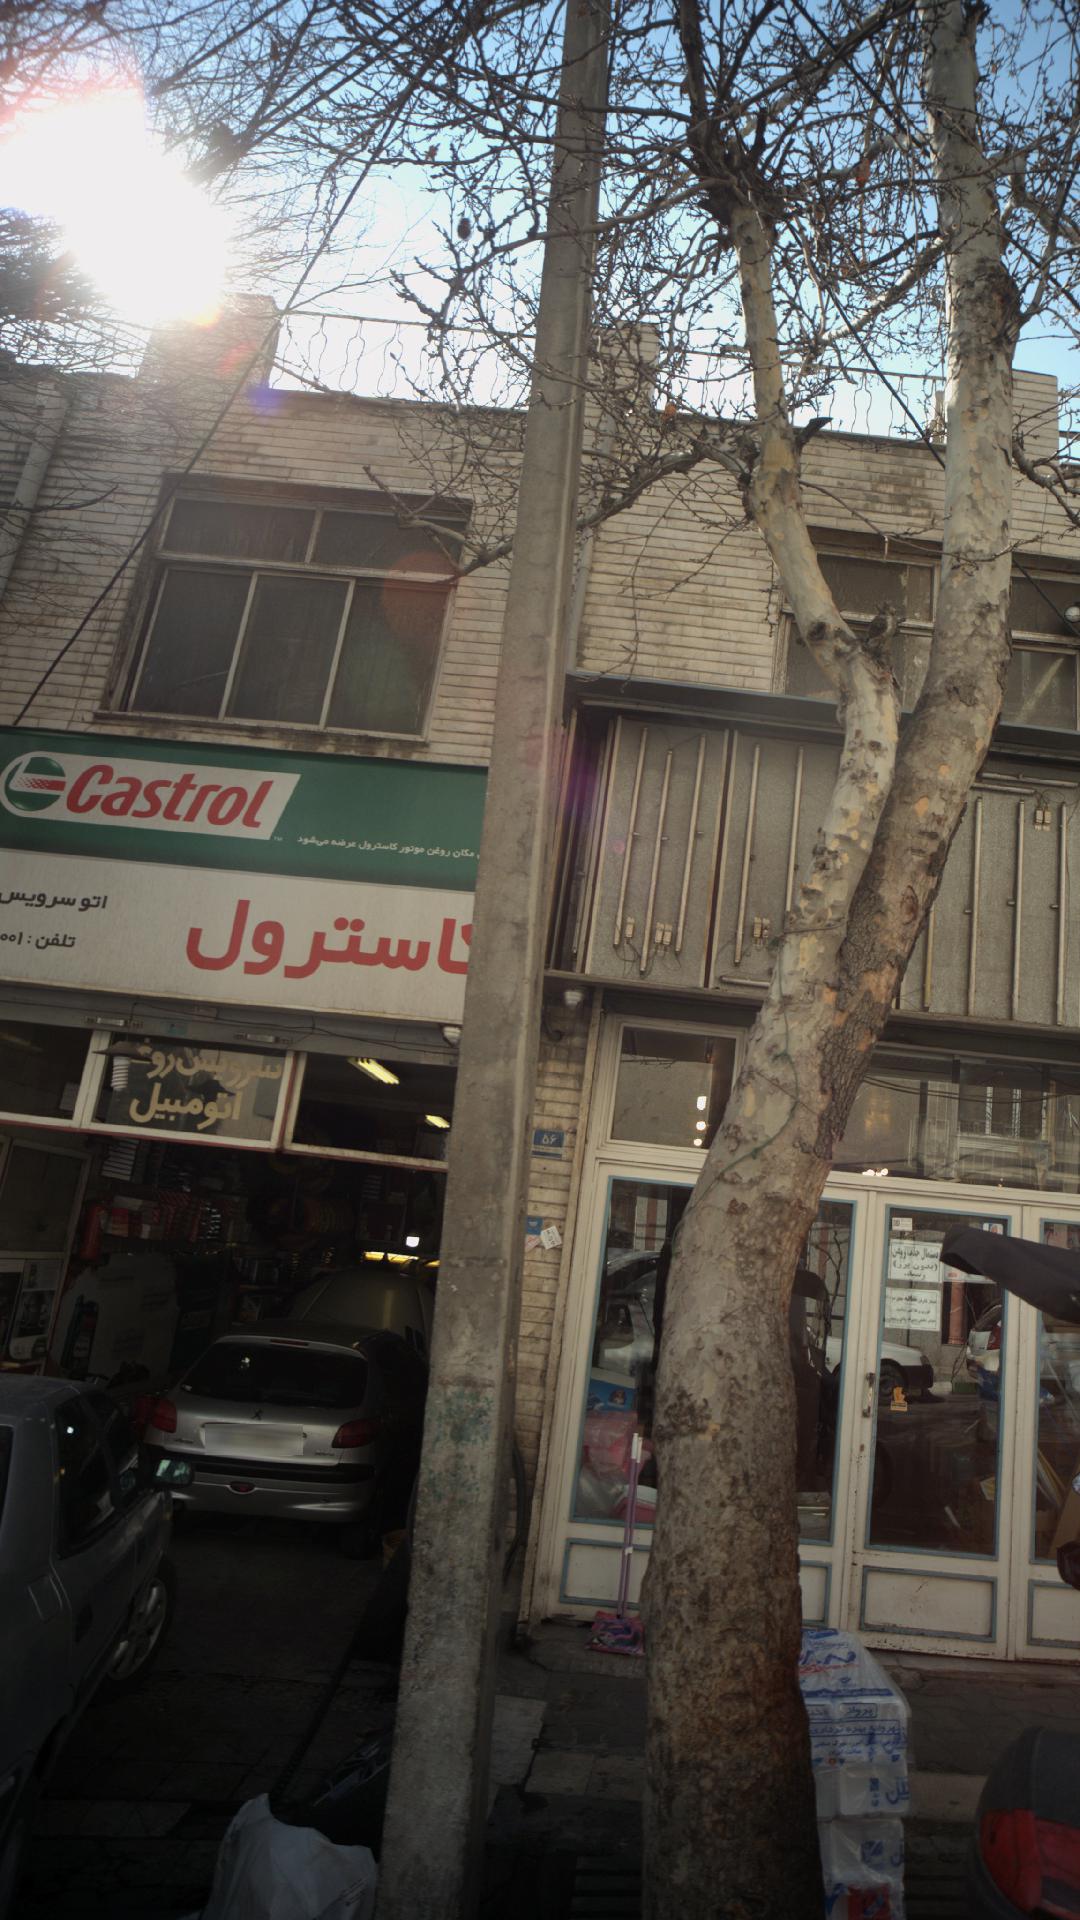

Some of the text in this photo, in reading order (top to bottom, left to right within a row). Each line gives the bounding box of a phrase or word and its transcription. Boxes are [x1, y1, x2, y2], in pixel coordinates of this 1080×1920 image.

[66, 764, 274, 828] Castrol
[330, 838, 356, 849] عرضه
[358, 840, 399, 851] کاسترول
[398, 845, 426, 856] موتور
[426, 846, 452, 858] روغن
[453, 848, 475, 859] مکان
[0, 890, 108, 912] اتو سرویس
[129, 1082, 242, 1131] اتومبیل
